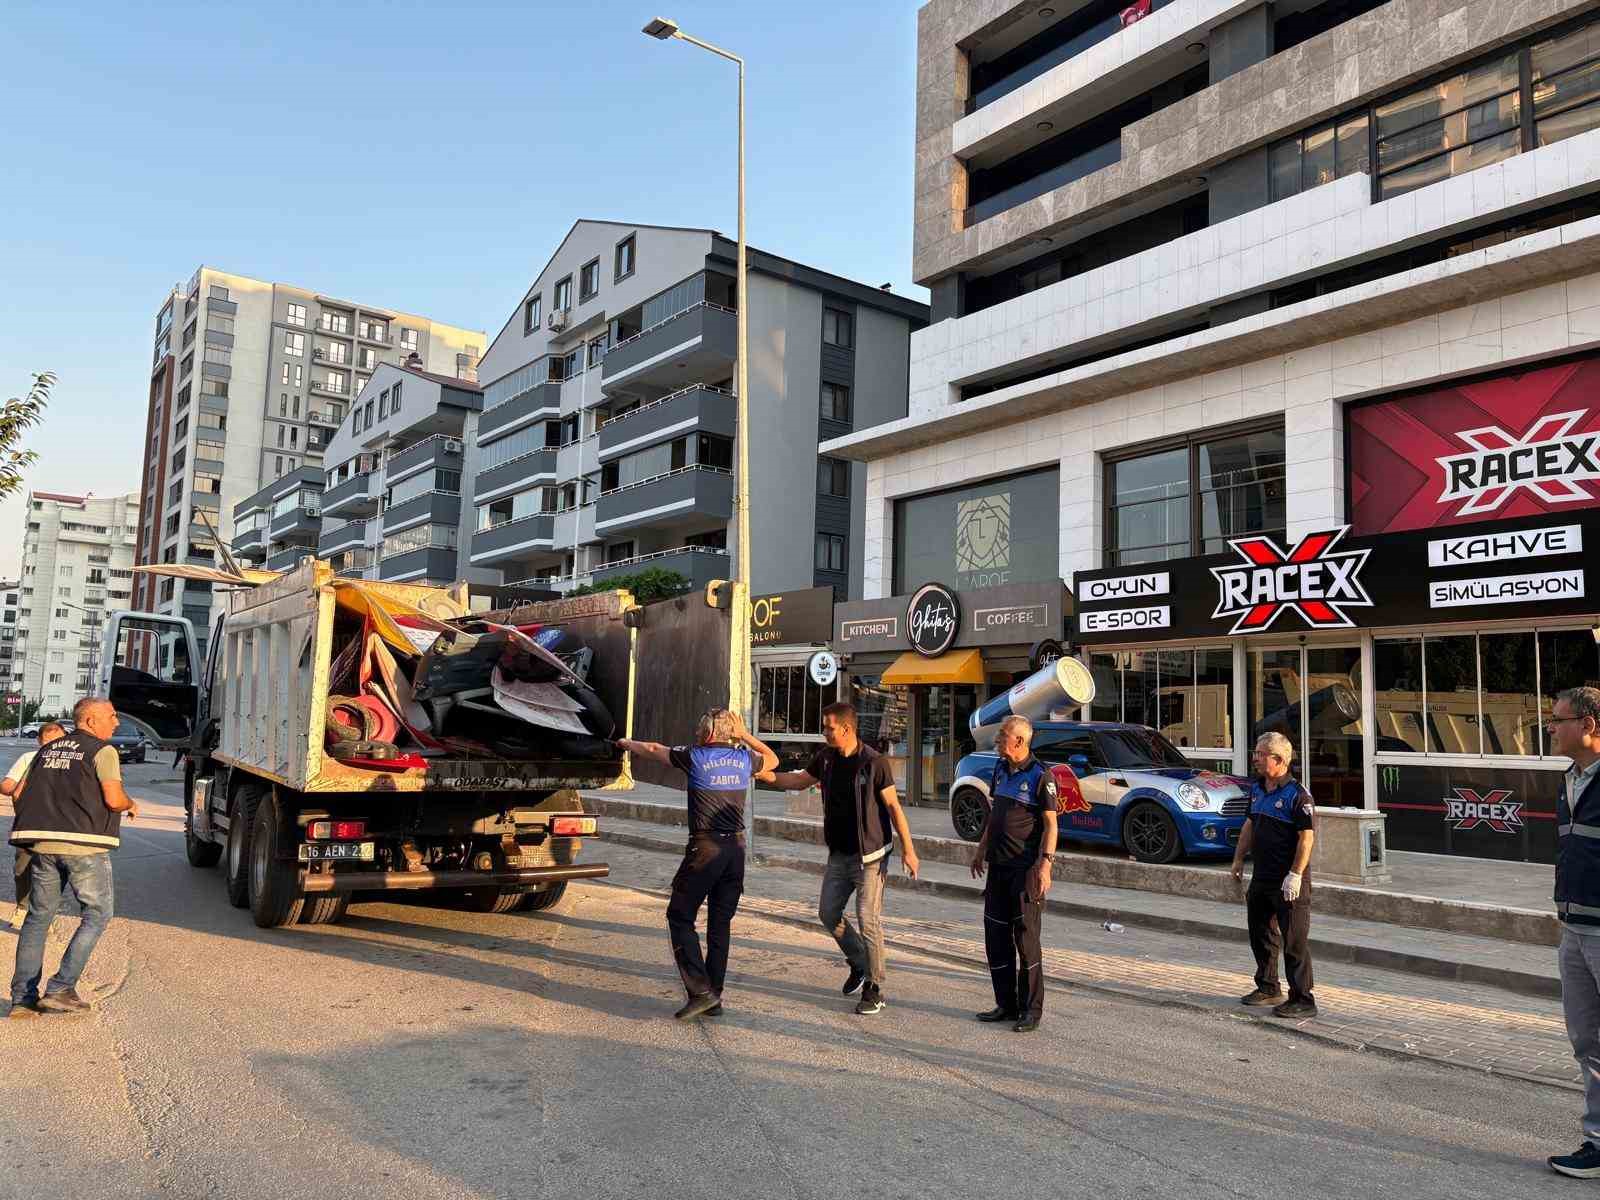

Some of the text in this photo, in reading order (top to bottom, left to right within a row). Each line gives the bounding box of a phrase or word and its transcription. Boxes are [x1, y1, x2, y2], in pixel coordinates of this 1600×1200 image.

[1448, 437, 1600, 494] RACEX
[1442, 530, 1567, 562] KAHVE
[1090, 577, 1156, 597] OYUN
[1221, 558, 1359, 610] RACEX
[1434, 576, 1579, 602] SİMÜLASYON
[986, 611, 1034, 625] COFFEE
[1087, 609, 1162, 629] E-SPOR
[849, 623, 888, 636] KITCHEN
[710, 775, 741, 785] ZABITA
[1449, 801, 1518, 822] RACEX
[308, 846, 319, 857] 16
[324, 845, 345, 857] AEN
